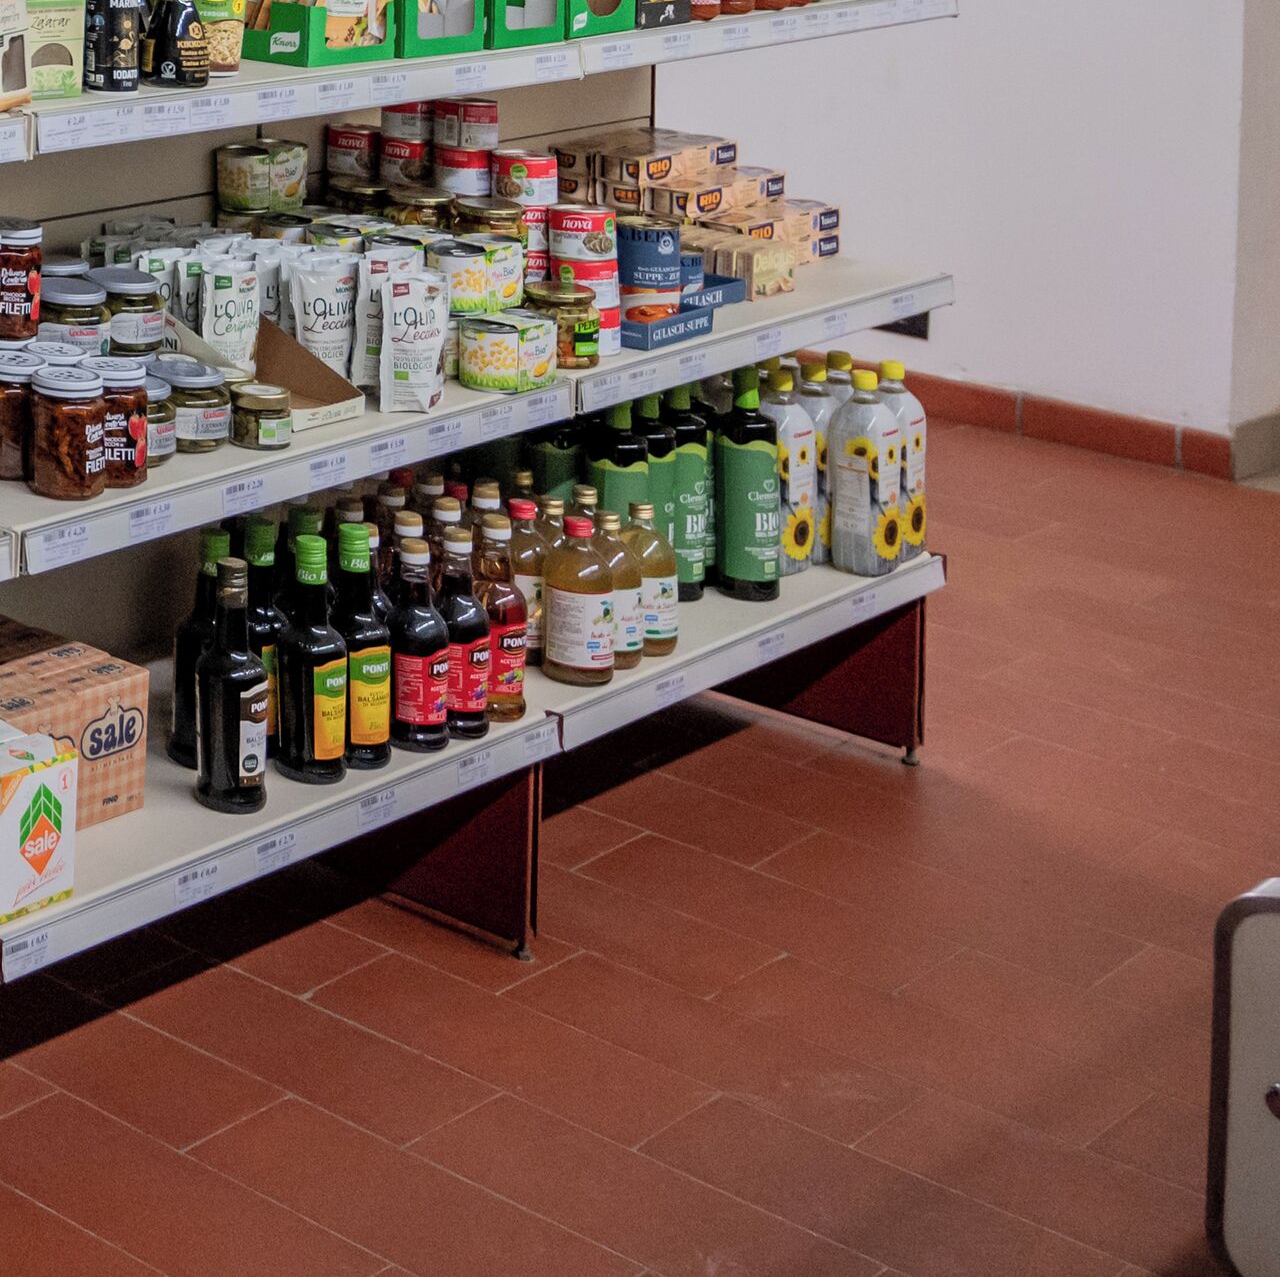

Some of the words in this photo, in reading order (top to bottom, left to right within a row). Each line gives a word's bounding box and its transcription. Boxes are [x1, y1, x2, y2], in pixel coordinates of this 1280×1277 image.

[272, 35, 298, 49] Knorr
[113, 70, 138, 79] IODATO
[384, 143, 410, 157] nova
[648, 159, 670, 174] RIO
[699, 192, 720, 206] RIO
[562, 217, 592, 230] nova
[653, 317, 709, 341] GULASCH-SUPPE
[393, 360, 432, 370] BIOLOGICA
[88, 713, 137, 752] sale
[24, 823, 58, 861] sale
